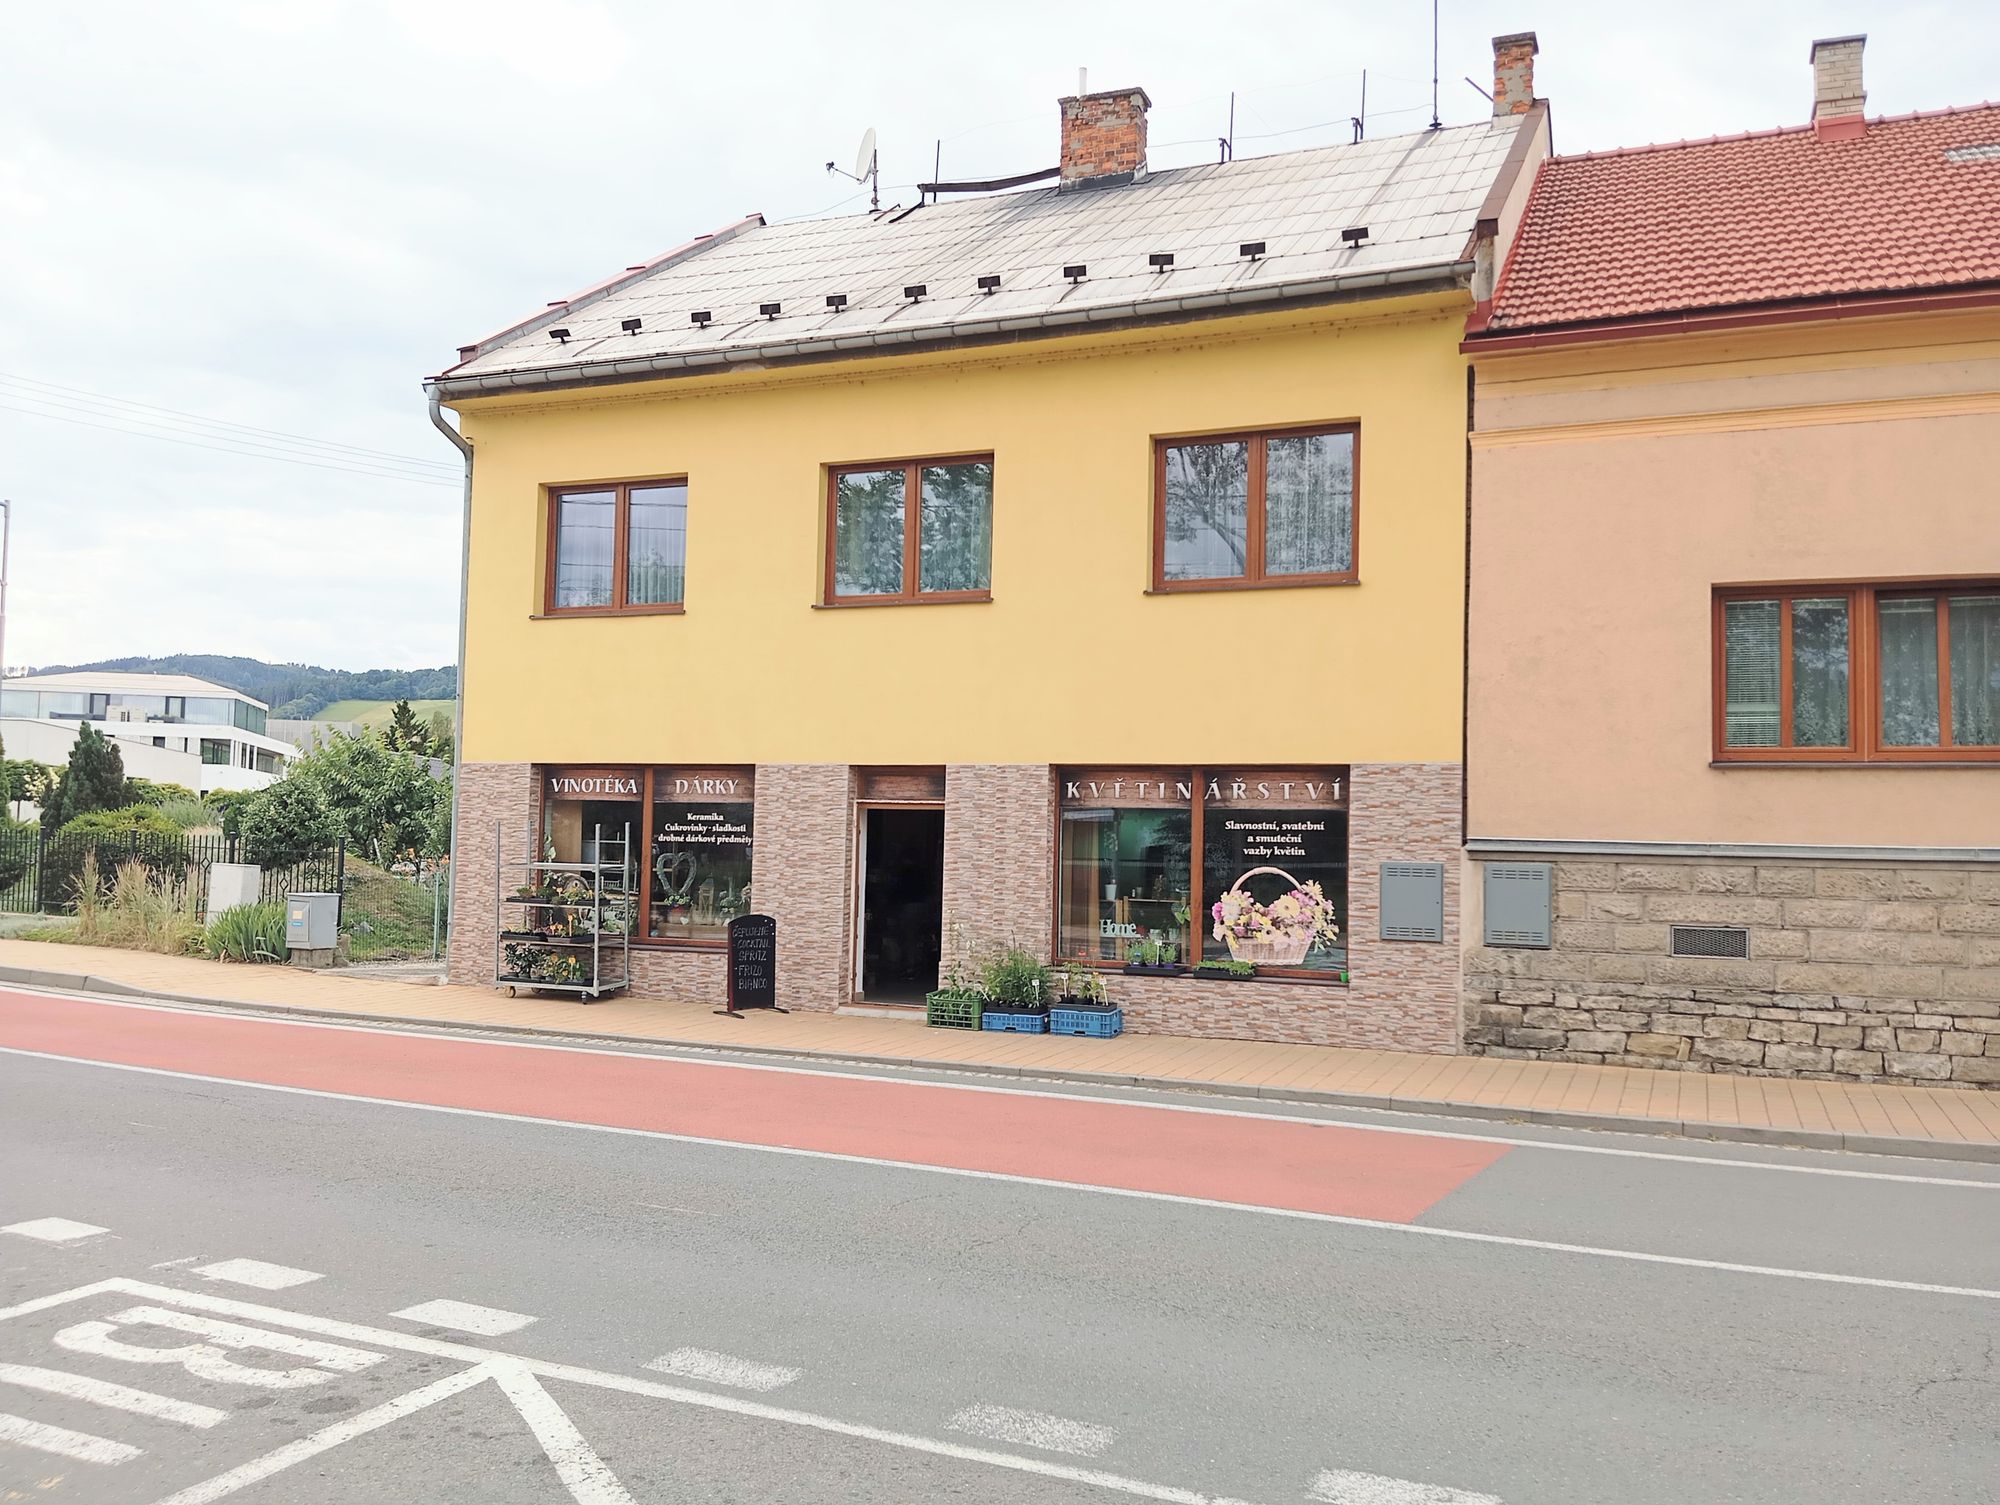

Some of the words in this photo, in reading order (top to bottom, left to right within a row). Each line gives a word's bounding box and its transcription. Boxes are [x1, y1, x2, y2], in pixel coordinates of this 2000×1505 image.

[551, 775, 638, 794] VINOTÉKA
[675, 776, 739, 794] DÁRKY
[1066, 778, 1341, 800] KVĚTINÁŘSTVÍ
[687, 813, 724, 821] Keramika
[665, 823, 708, 834] Cukrovinky
[712, 823, 746, 832] sladkosti
[1225, 820, 1280, 831] Slavnostní,
[1281, 821, 1325, 830] svatební
[658, 834, 685, 842] drobné
[686, 834, 715, 843] dárkové
[717, 835, 753, 846] předměty
[1256, 834, 1302, 843] smuteční
[1243, 846, 1272, 858] vazby
[1274, 846, 1306, 856] květin
[1100, 919, 1137, 936] Home
[738, 950, 767, 961] SPRITZ
